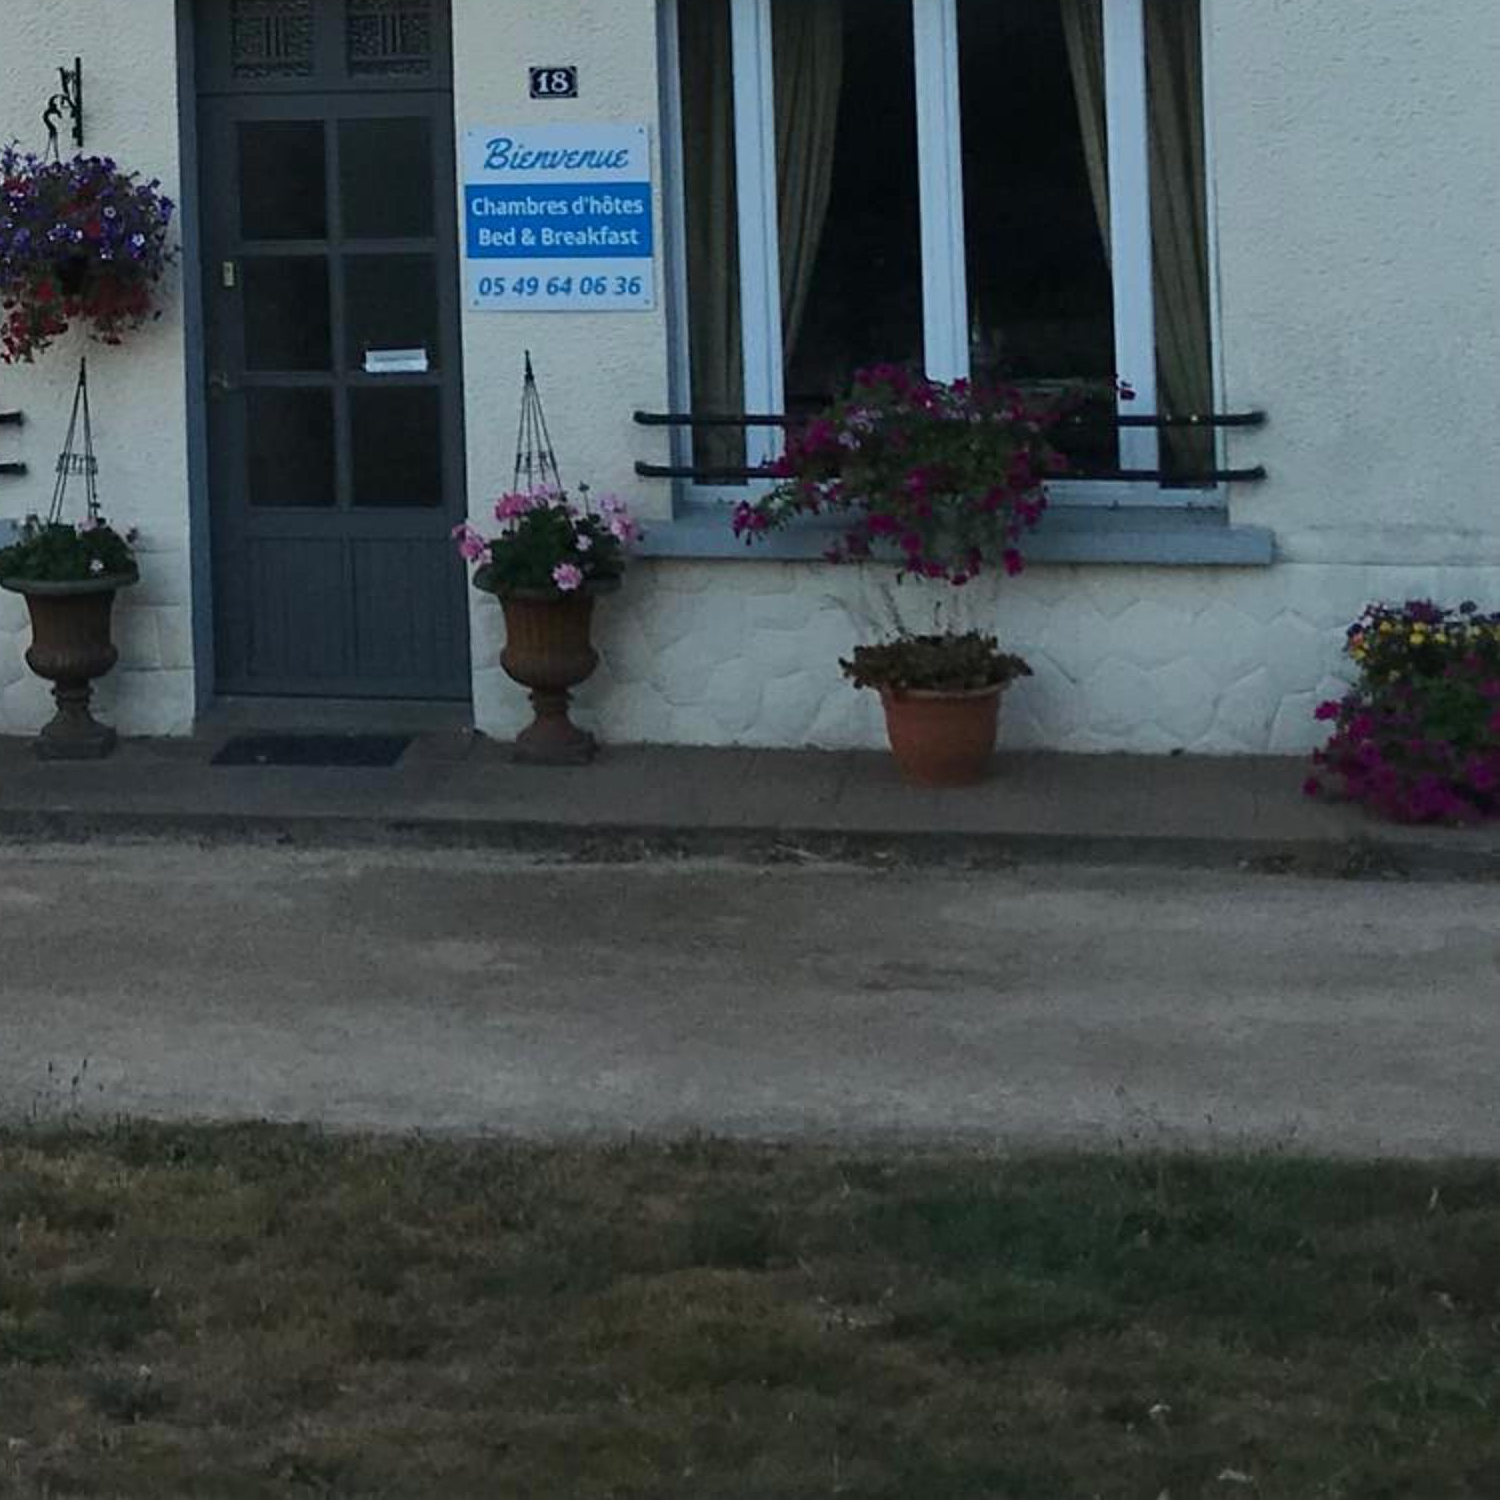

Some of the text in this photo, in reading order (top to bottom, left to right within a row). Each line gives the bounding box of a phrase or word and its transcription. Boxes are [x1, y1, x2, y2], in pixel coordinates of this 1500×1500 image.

[536, 70, 569, 94] 18
[484, 137, 629, 170] Bienvenue
[471, 195, 644, 216] Chambres d'hôtes
[478, 226, 640, 246] Bed & Breakfast
[478, 276, 642, 296] 05 49 64 06 36
